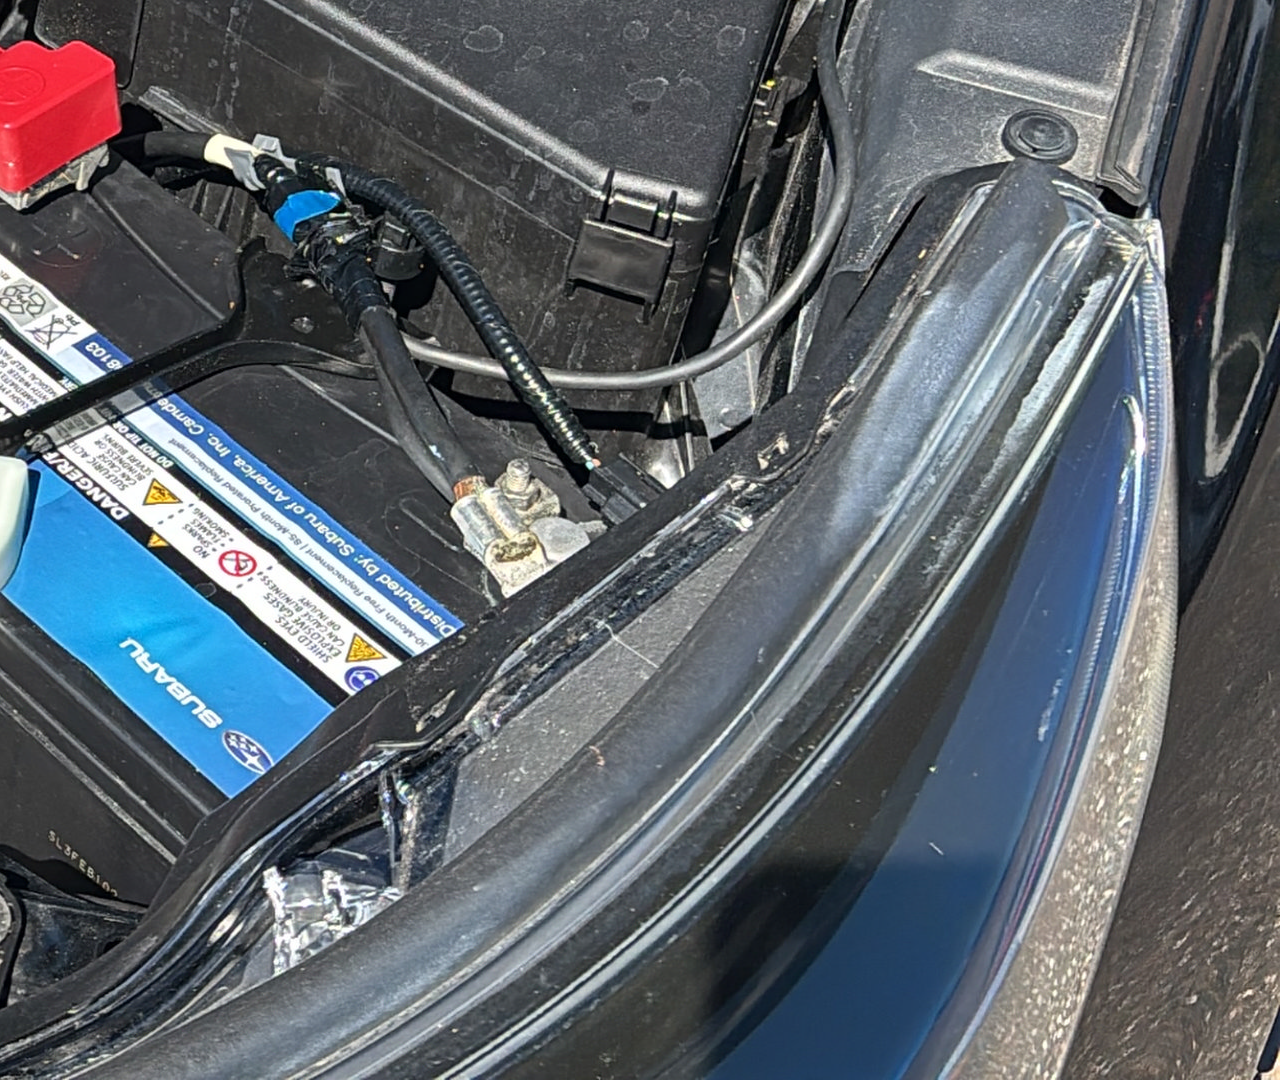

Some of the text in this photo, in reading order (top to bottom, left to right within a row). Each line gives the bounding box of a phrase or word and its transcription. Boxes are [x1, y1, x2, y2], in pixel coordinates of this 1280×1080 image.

[154, 397, 206, 435] Camde
[113, 420, 173, 467] DO NOT TIP OR
[166, 436, 226, 482] Replacement
[201, 433, 233, 456] Inc.
[85, 456, 129, 490] SULFURIC
[96, 452, 138, 485] CAN CAUSE
[104, 447, 147, 481] BLINDNESS
[125, 453, 154, 475] SEVERE
[225, 452, 293, 504] America,
[221, 481, 262, 512] Prorated
[283, 500, 306, 516] of
[180, 522, 213, 548] SPARKS
[189, 517, 222, 543] FLAMES
[190, 506, 230, 538] SMOKING
[258, 510, 303, 545] 85-Month
[299, 512, 358, 557] Subaru
[191, 544, 210, 558] NO
[350, 551, 385, 576] by:
[302, 547, 367, 597] Replacement
[257, 574, 346, 646] CAN CAUSE BLINDNESS
[361, 594, 387, 614] Free
[374, 572, 457, 636] Distributed
[261, 591, 343, 657] EXPLOSIVE GASES
[326, 619, 342, 631] OR
[296, 634, 333, 663] SHIELD
[114, 636, 227, 730] SUBARU
